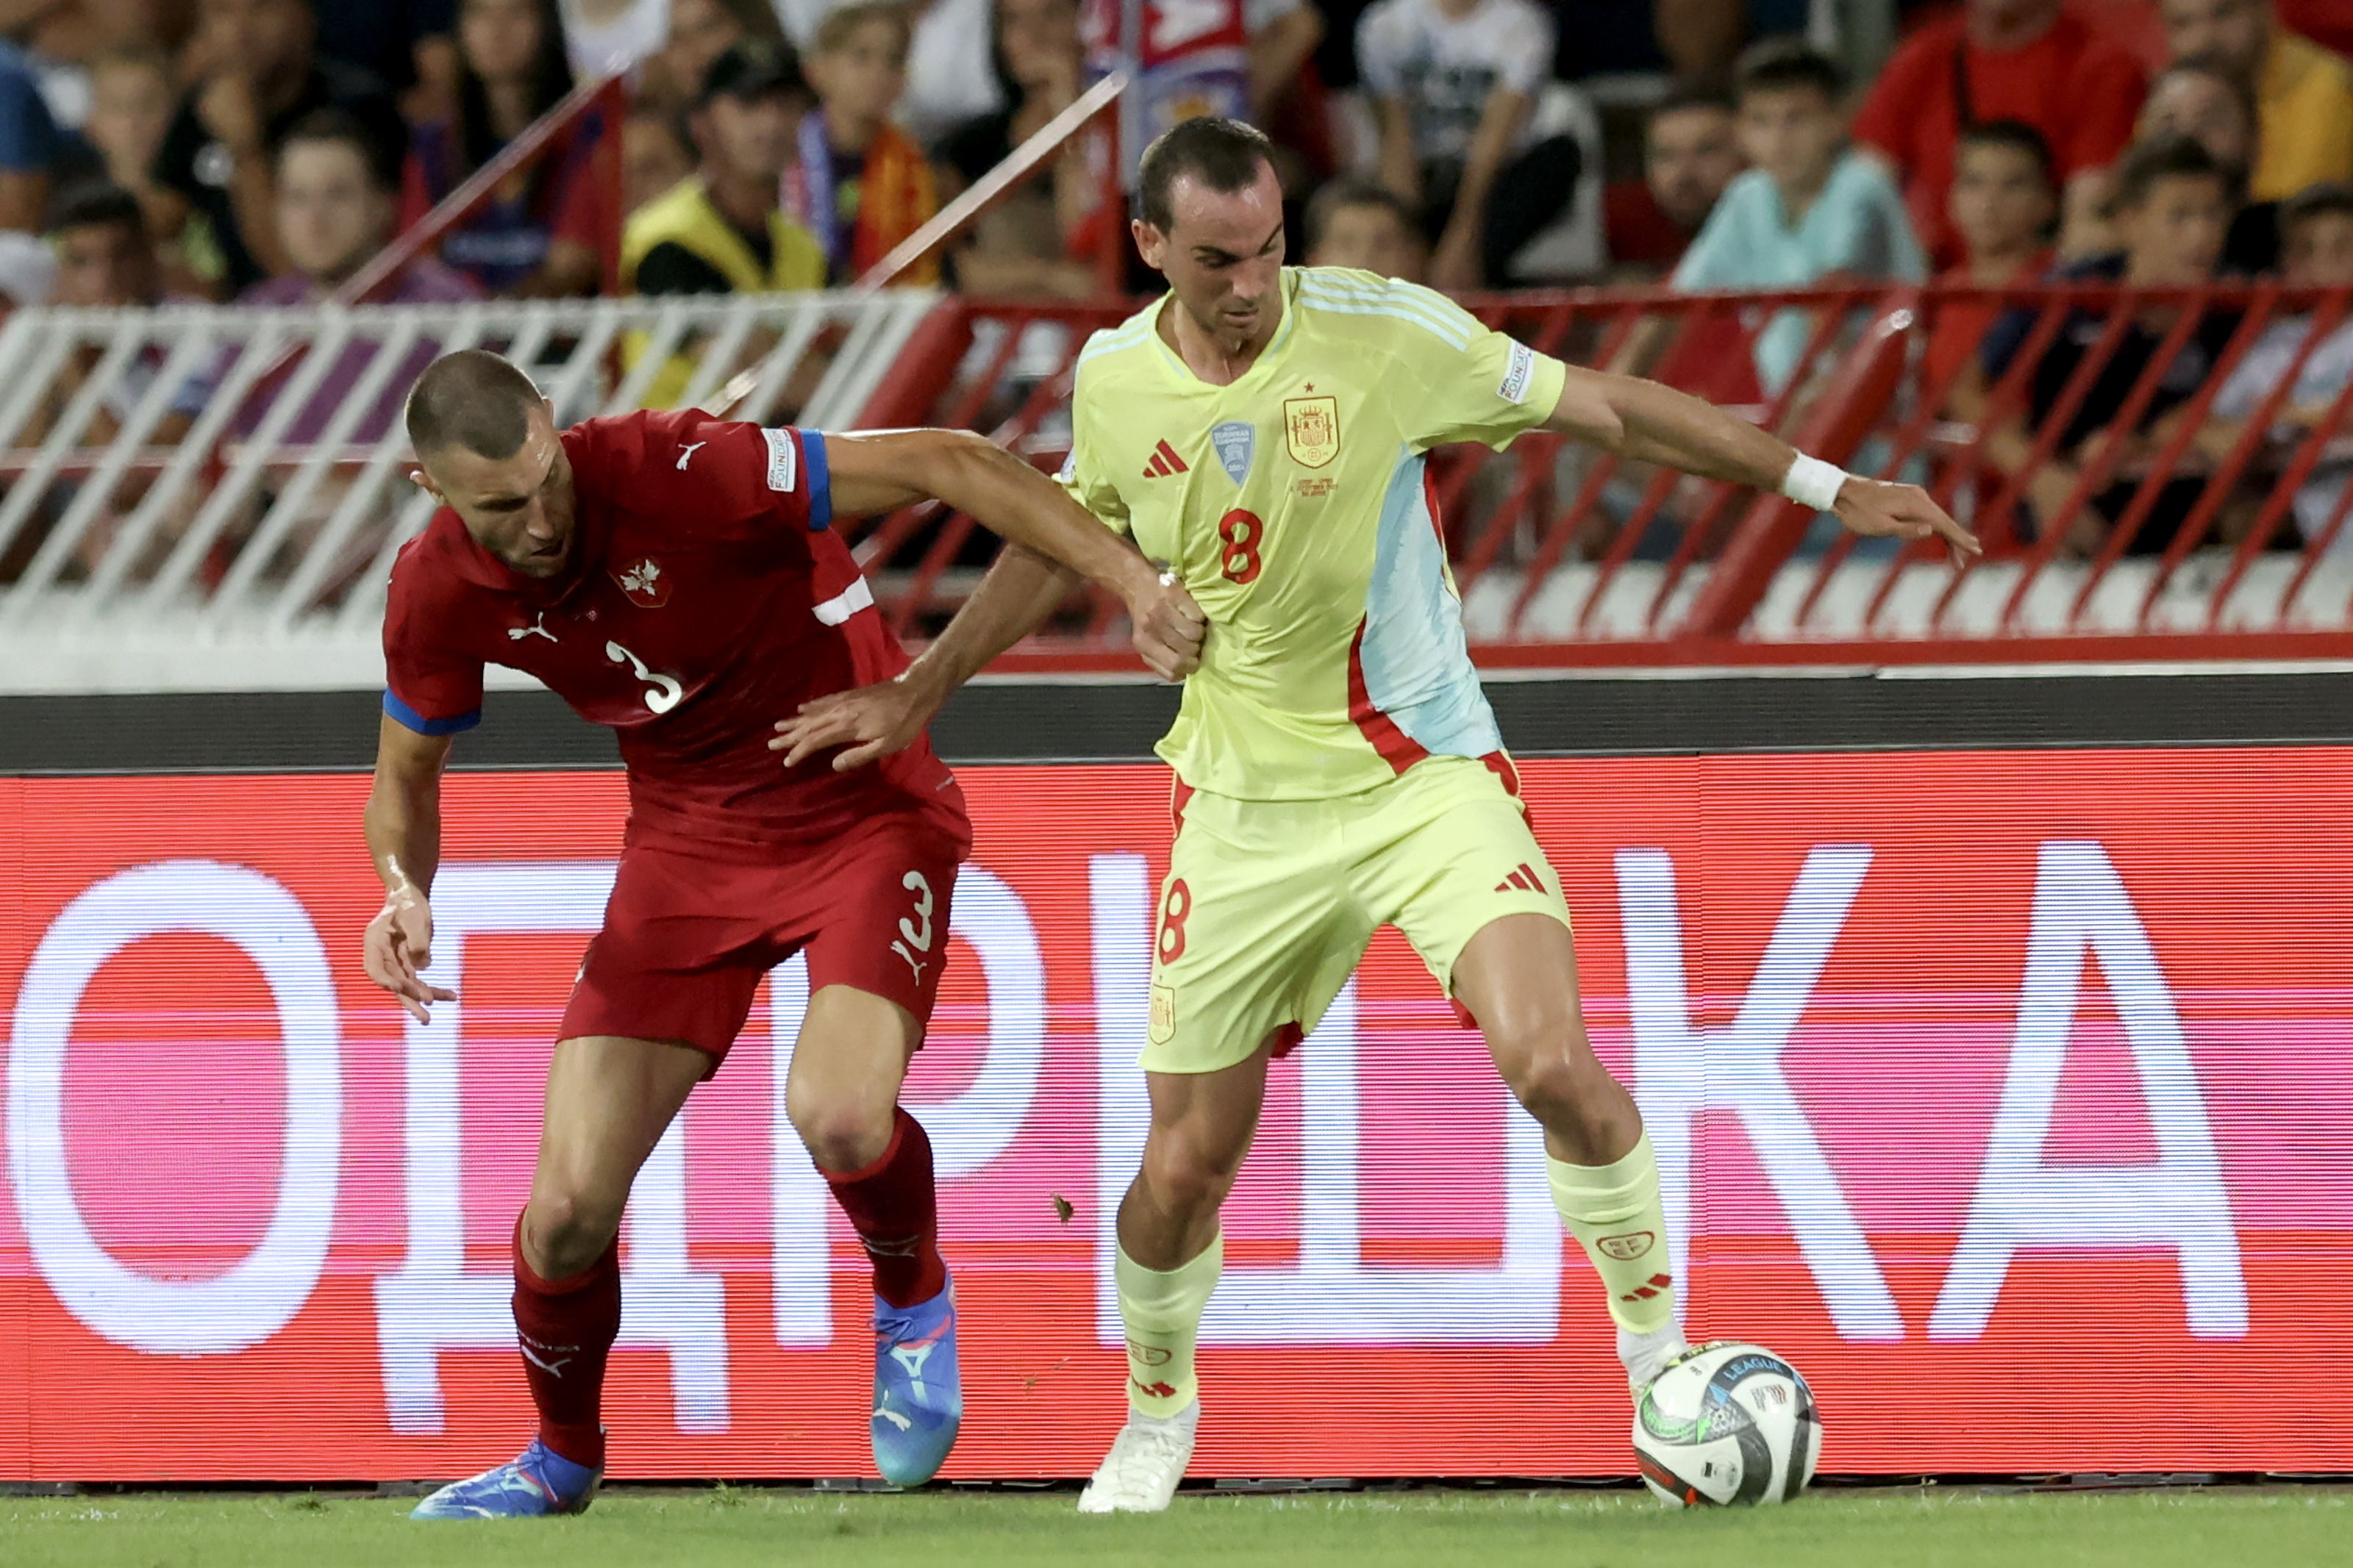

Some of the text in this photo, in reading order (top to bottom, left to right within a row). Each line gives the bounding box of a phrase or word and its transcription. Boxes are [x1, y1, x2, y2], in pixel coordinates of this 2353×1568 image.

[1218, 508, 1264, 584] 8
[605, 639, 684, 715] 3
[898, 870, 935, 953] 3
[1158, 877, 1192, 966] 8
[1723, 1358, 1784, 1381] LEAGUE
